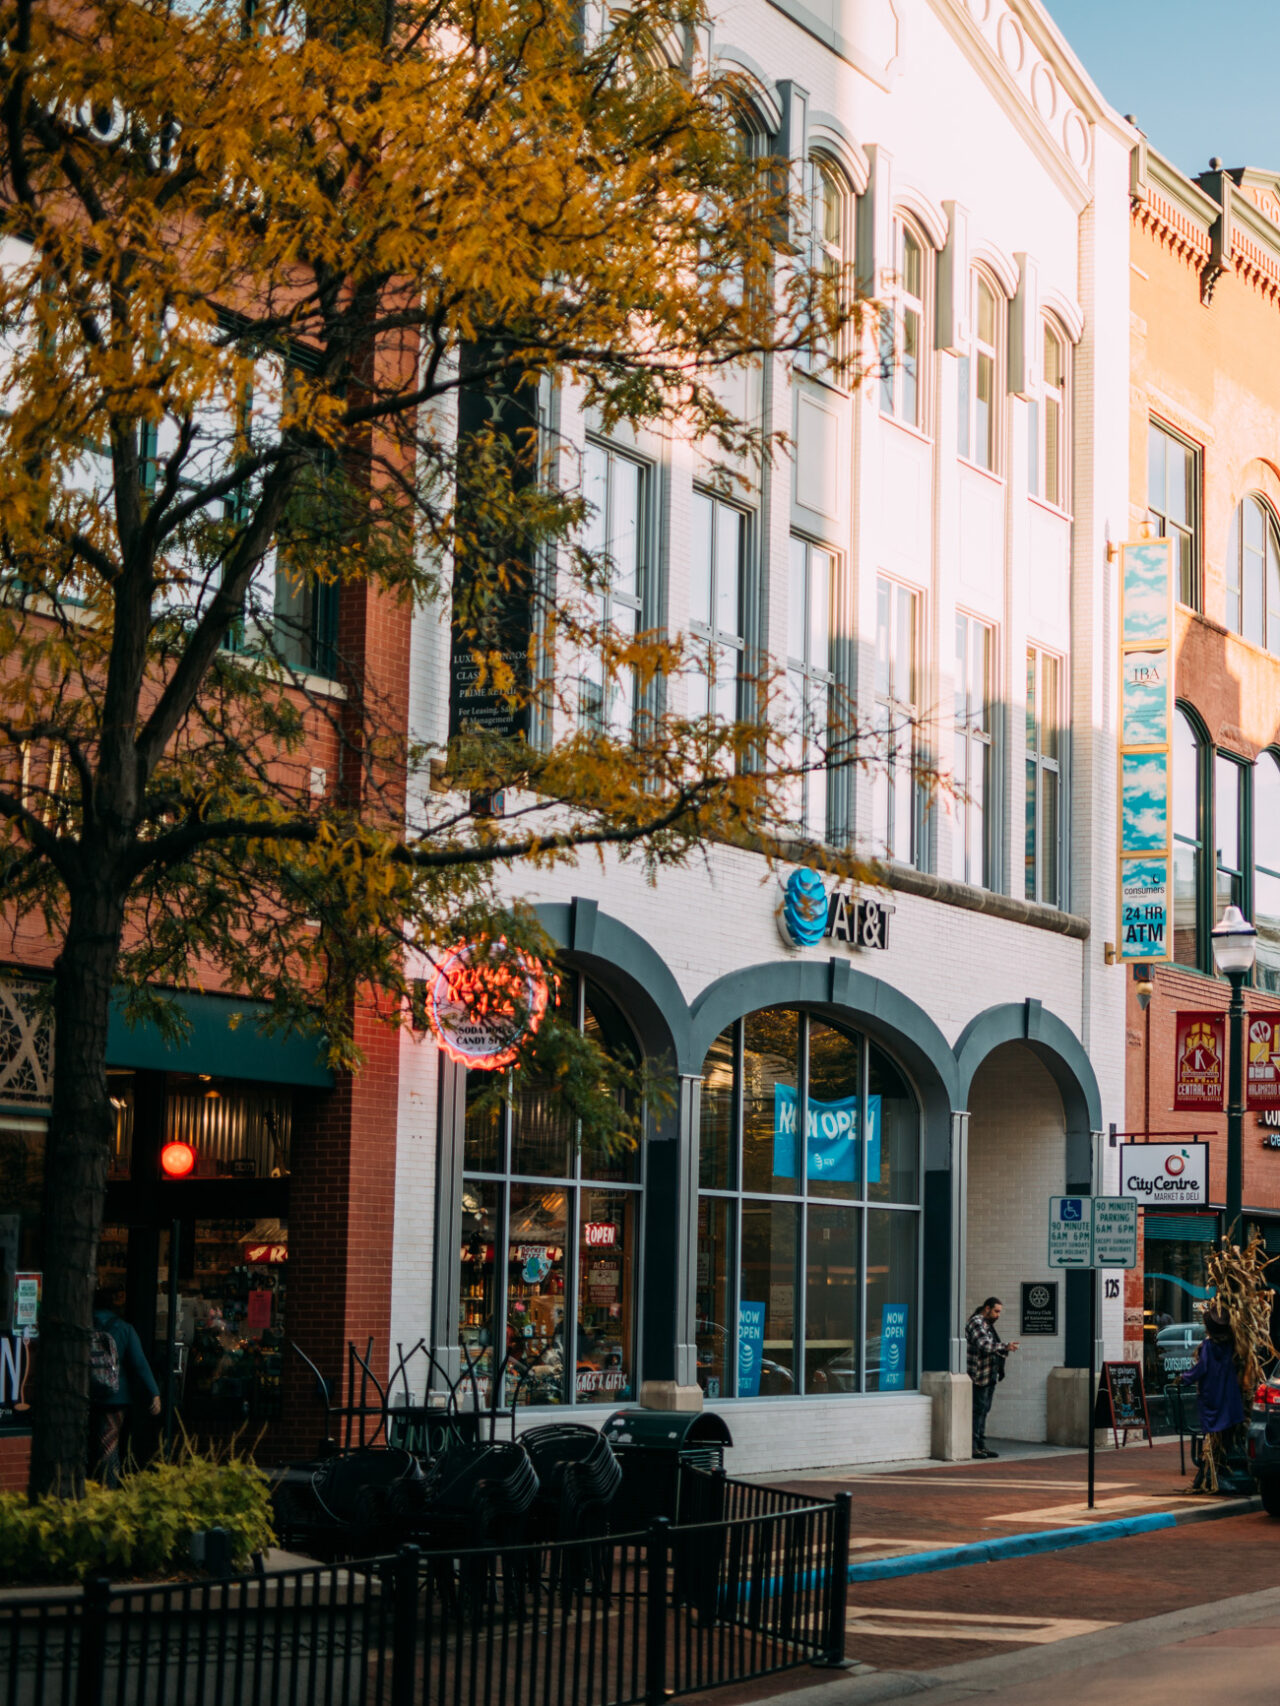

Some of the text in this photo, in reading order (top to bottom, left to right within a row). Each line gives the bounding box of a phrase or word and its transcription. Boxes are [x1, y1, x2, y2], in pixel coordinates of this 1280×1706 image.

[1124, 886, 1165, 895] consumers
[1125, 905, 1163, 921] 24 HR
[830, 892, 896, 950] AT&T
[1125, 923, 1164, 943] ATM
[456, 1036, 486, 1045] CANDY
[1194, 1049, 1207, 1070] K
[1177, 1083, 1222, 1096] CENTRAL CITY
[1154, 1192, 1200, 1201] MARKET & DELI
[1096, 1202, 1134, 1211] 90 MINUTE
[1100, 1213, 1130, 1222] PARKING
[1051, 1222, 1090, 1231] 90 MINUTE
[1096, 1224, 1134, 1234] 6AM 6PM
[590, 1226, 615, 1244] OPEN
[1051, 1232, 1090, 1241] 6AM 6PM
[1105, 1279, 1120, 1298] 125
[739, 1310, 761, 1324] NOW
[886, 1312, 904, 1325] NOW
[738, 1325, 760, 1339] OPEN
[885, 1326, 905, 1339] OPEN
[576, 1376, 595, 1392] GAGS
[605, 1373, 627, 1390] GIFTS
[885, 1374, 900, 1384] AT&T
